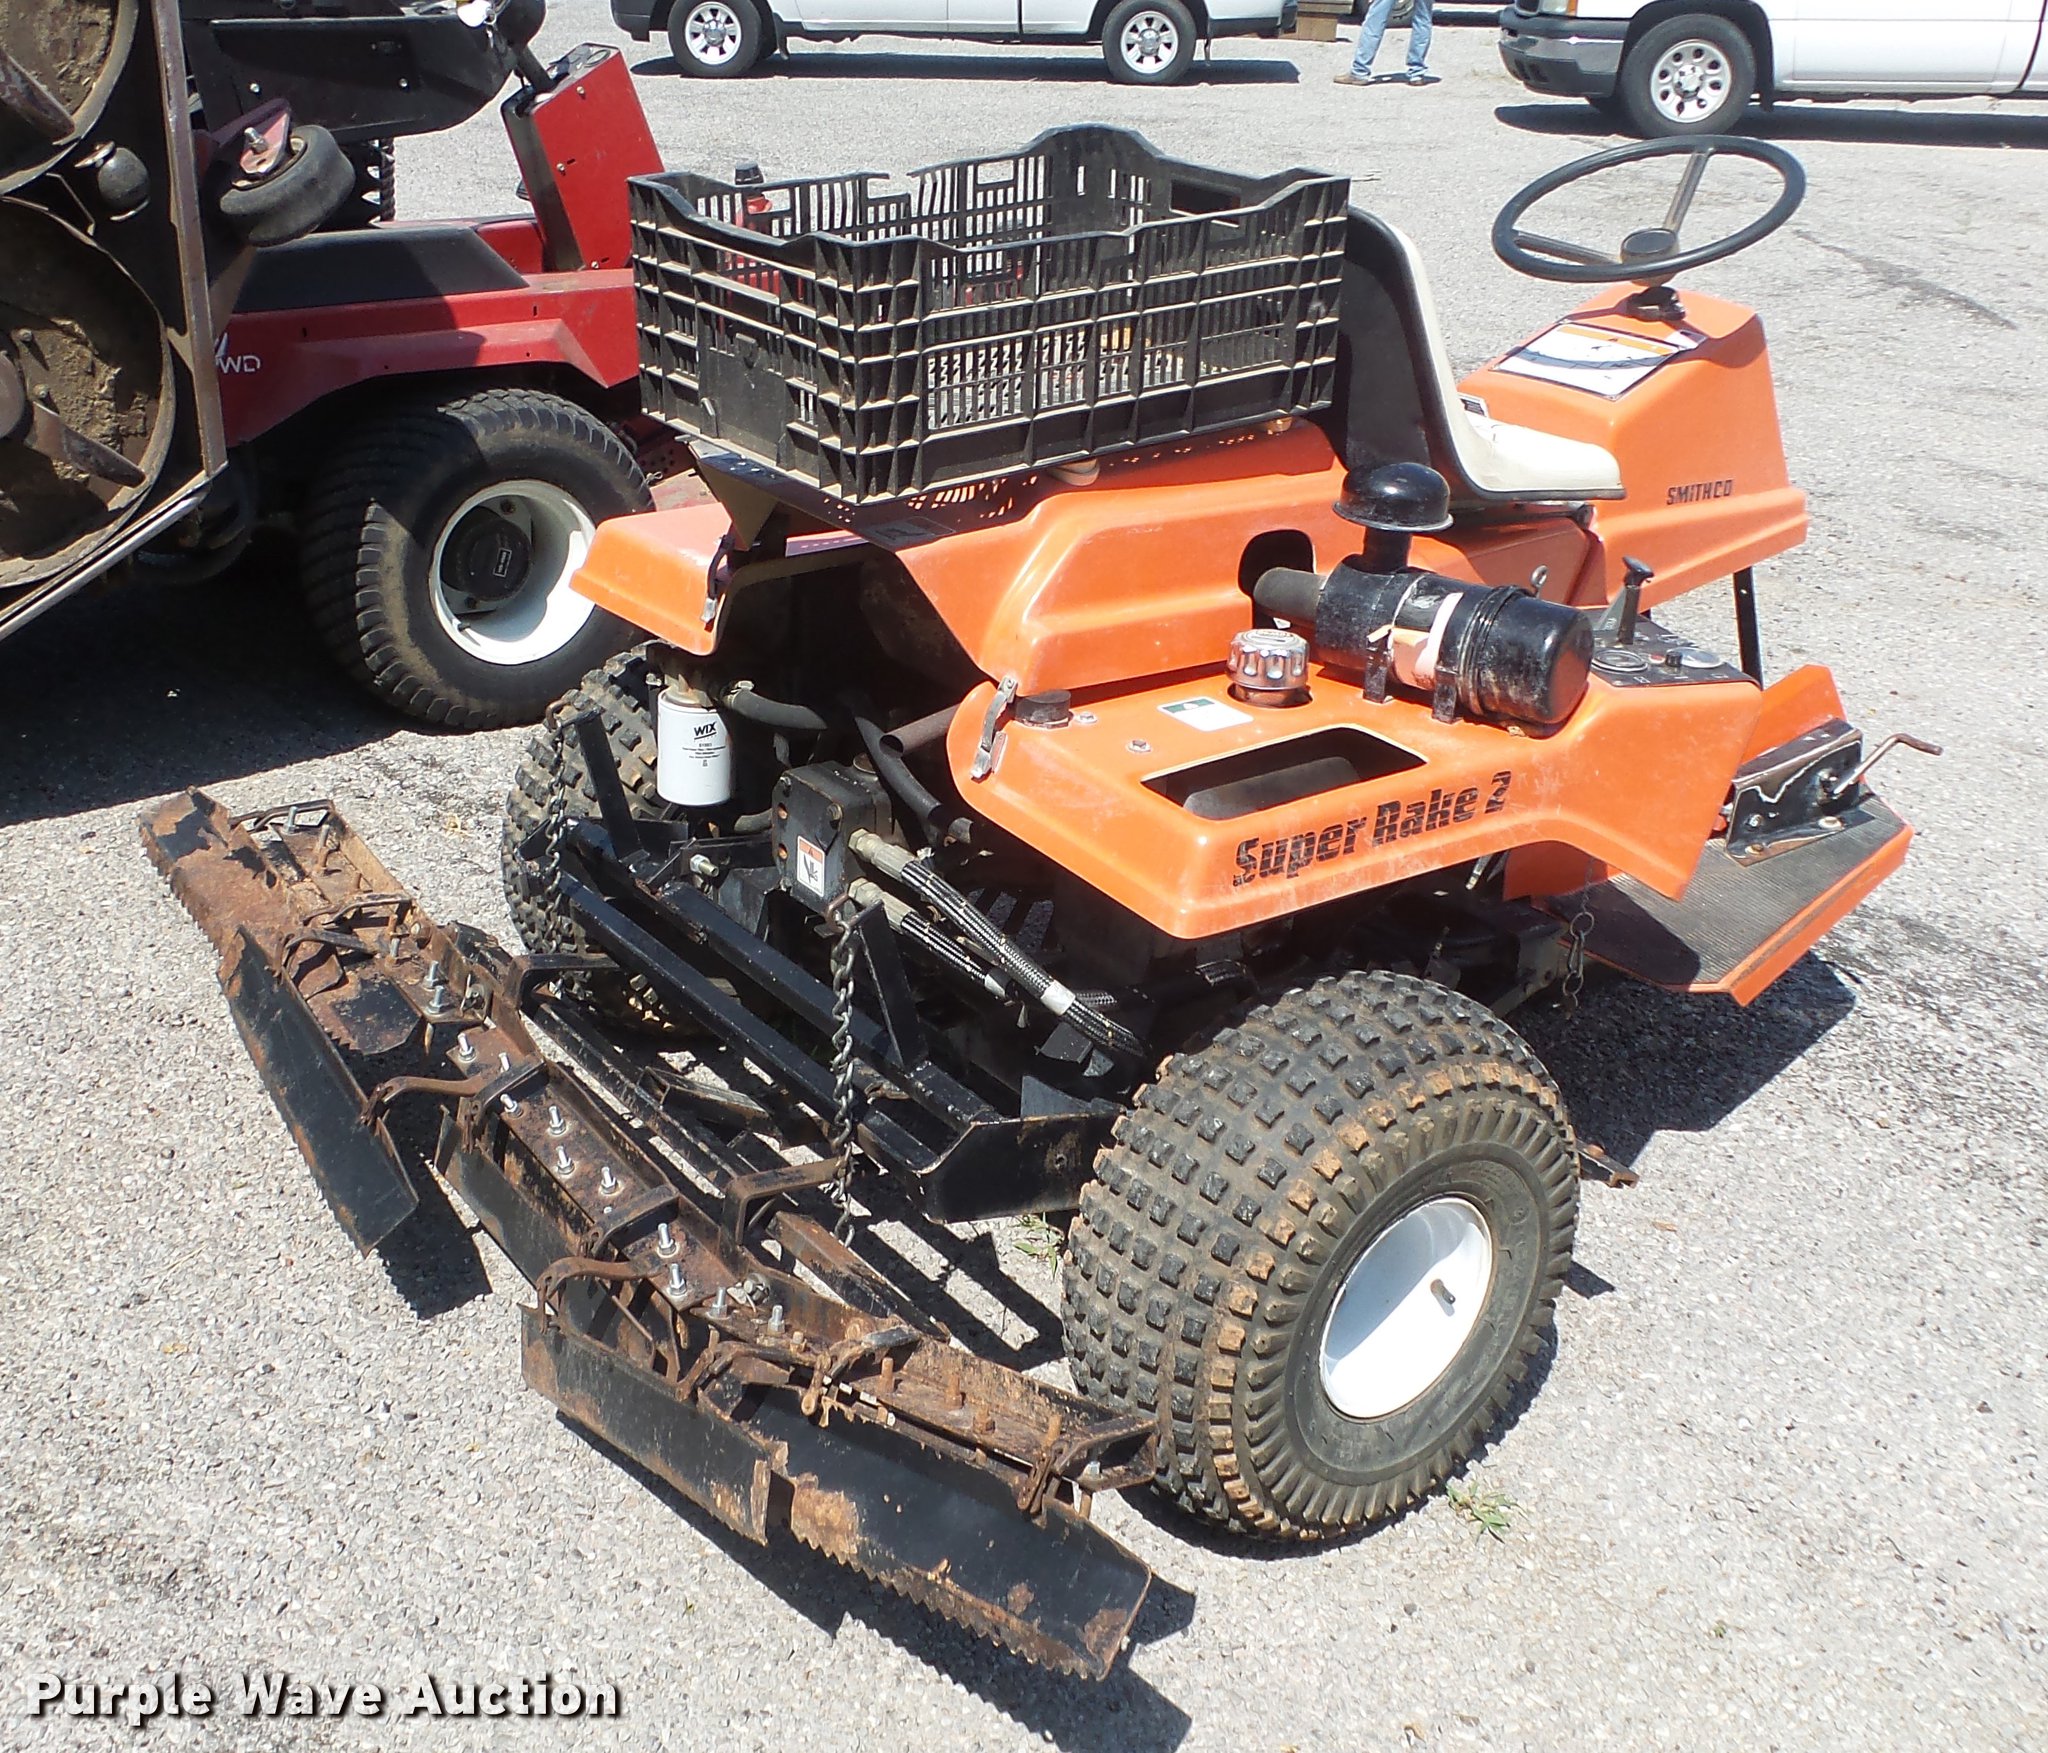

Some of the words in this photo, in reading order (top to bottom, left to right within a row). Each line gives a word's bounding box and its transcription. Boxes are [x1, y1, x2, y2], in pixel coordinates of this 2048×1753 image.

[693, 720, 718, 737] WIX
[1233, 816, 1368, 887] Super
[1372, 787, 1479, 847] Rake
[1484, 771, 1512, 814] 2
